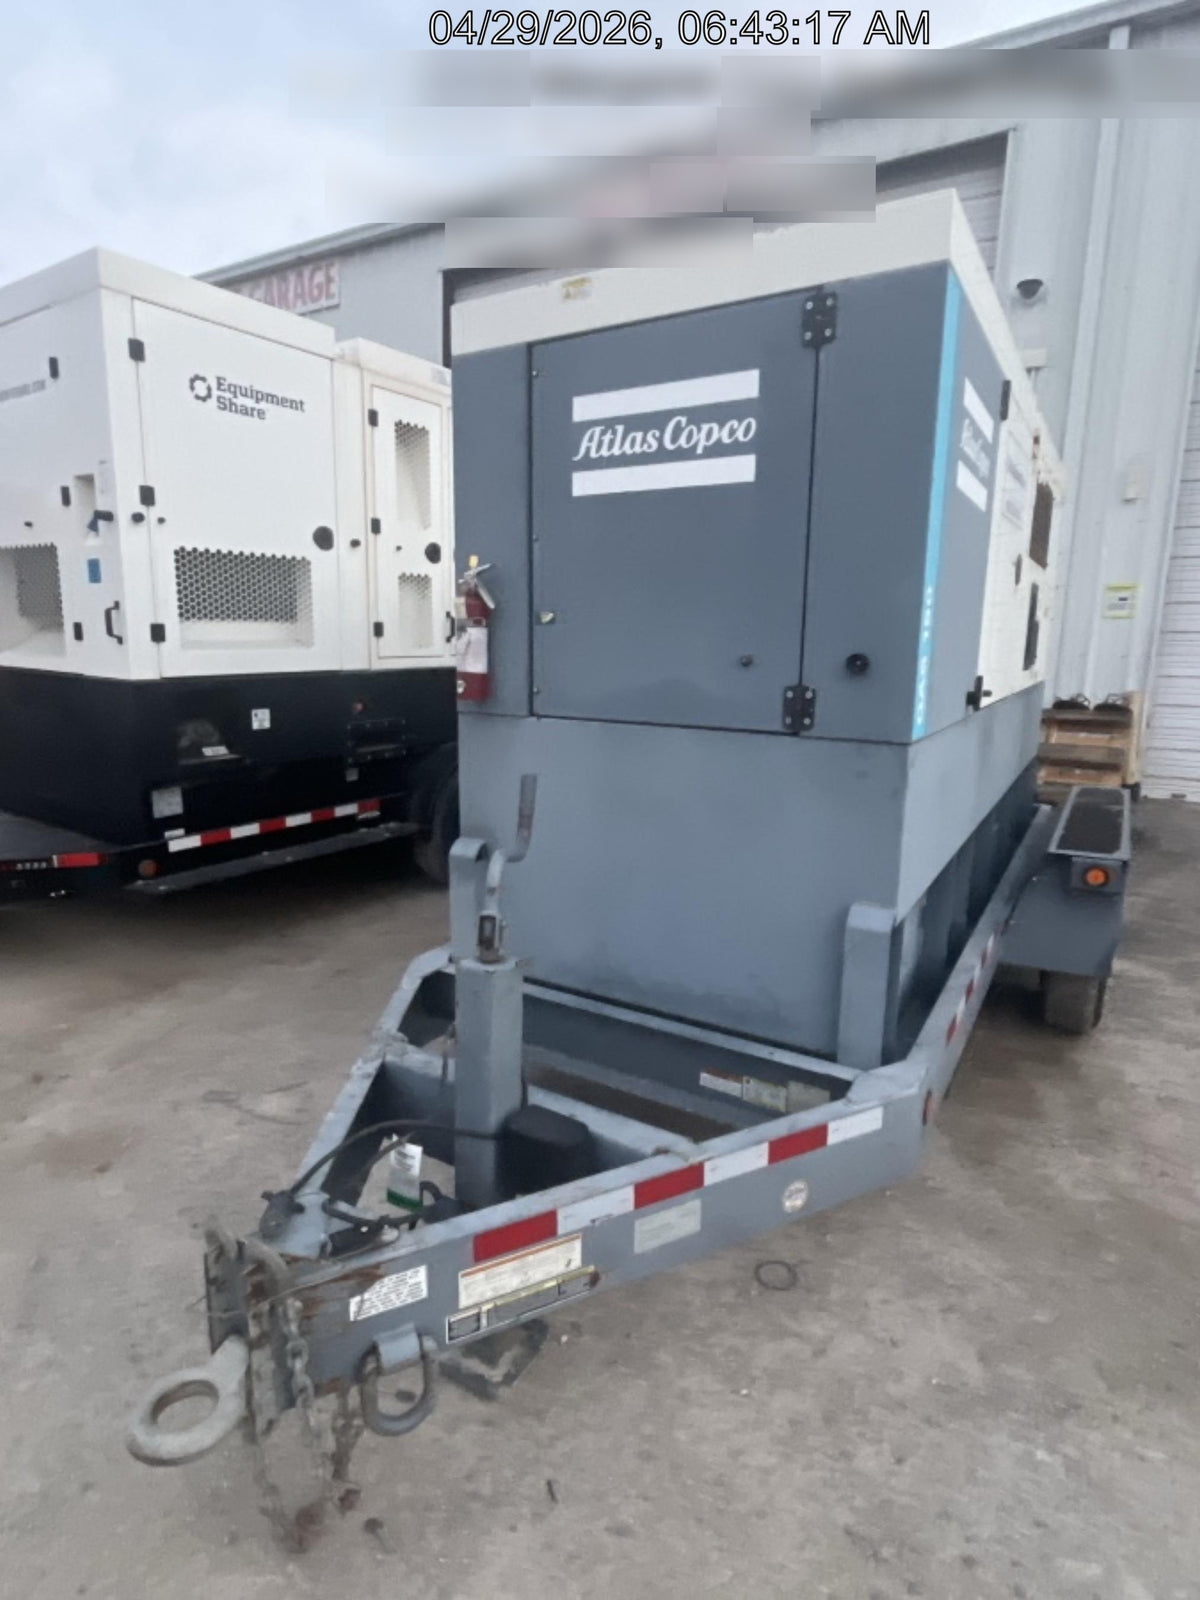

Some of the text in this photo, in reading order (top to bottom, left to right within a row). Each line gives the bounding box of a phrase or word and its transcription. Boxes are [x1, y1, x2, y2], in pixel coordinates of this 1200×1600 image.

[215, 376, 305, 412] Equipment
[216, 396, 266, 420] Share
[572, 415, 757, 462] Atlas Copco
